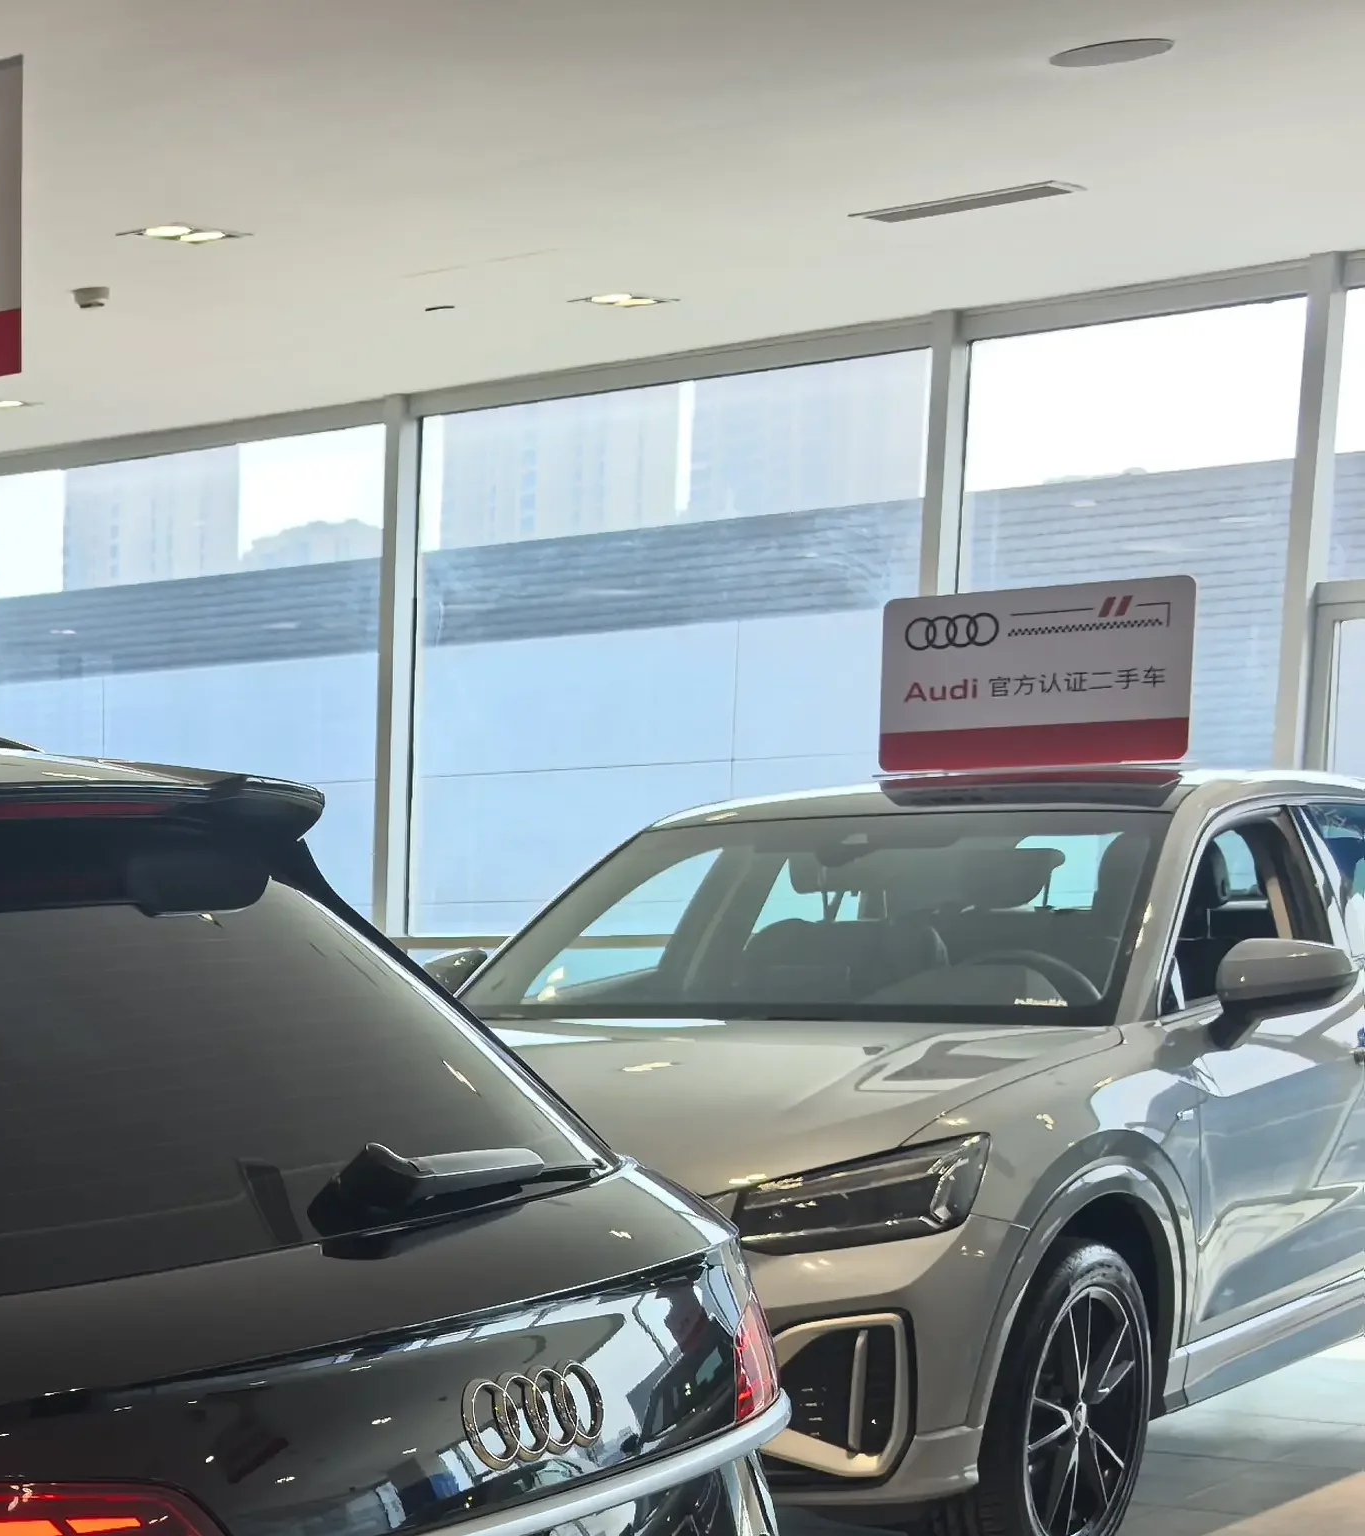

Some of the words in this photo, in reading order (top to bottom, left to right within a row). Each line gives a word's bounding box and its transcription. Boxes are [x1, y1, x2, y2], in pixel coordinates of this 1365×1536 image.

[903, 678, 979, 704] Audi
[988, 665, 1166, 698] 官方认证二手车
